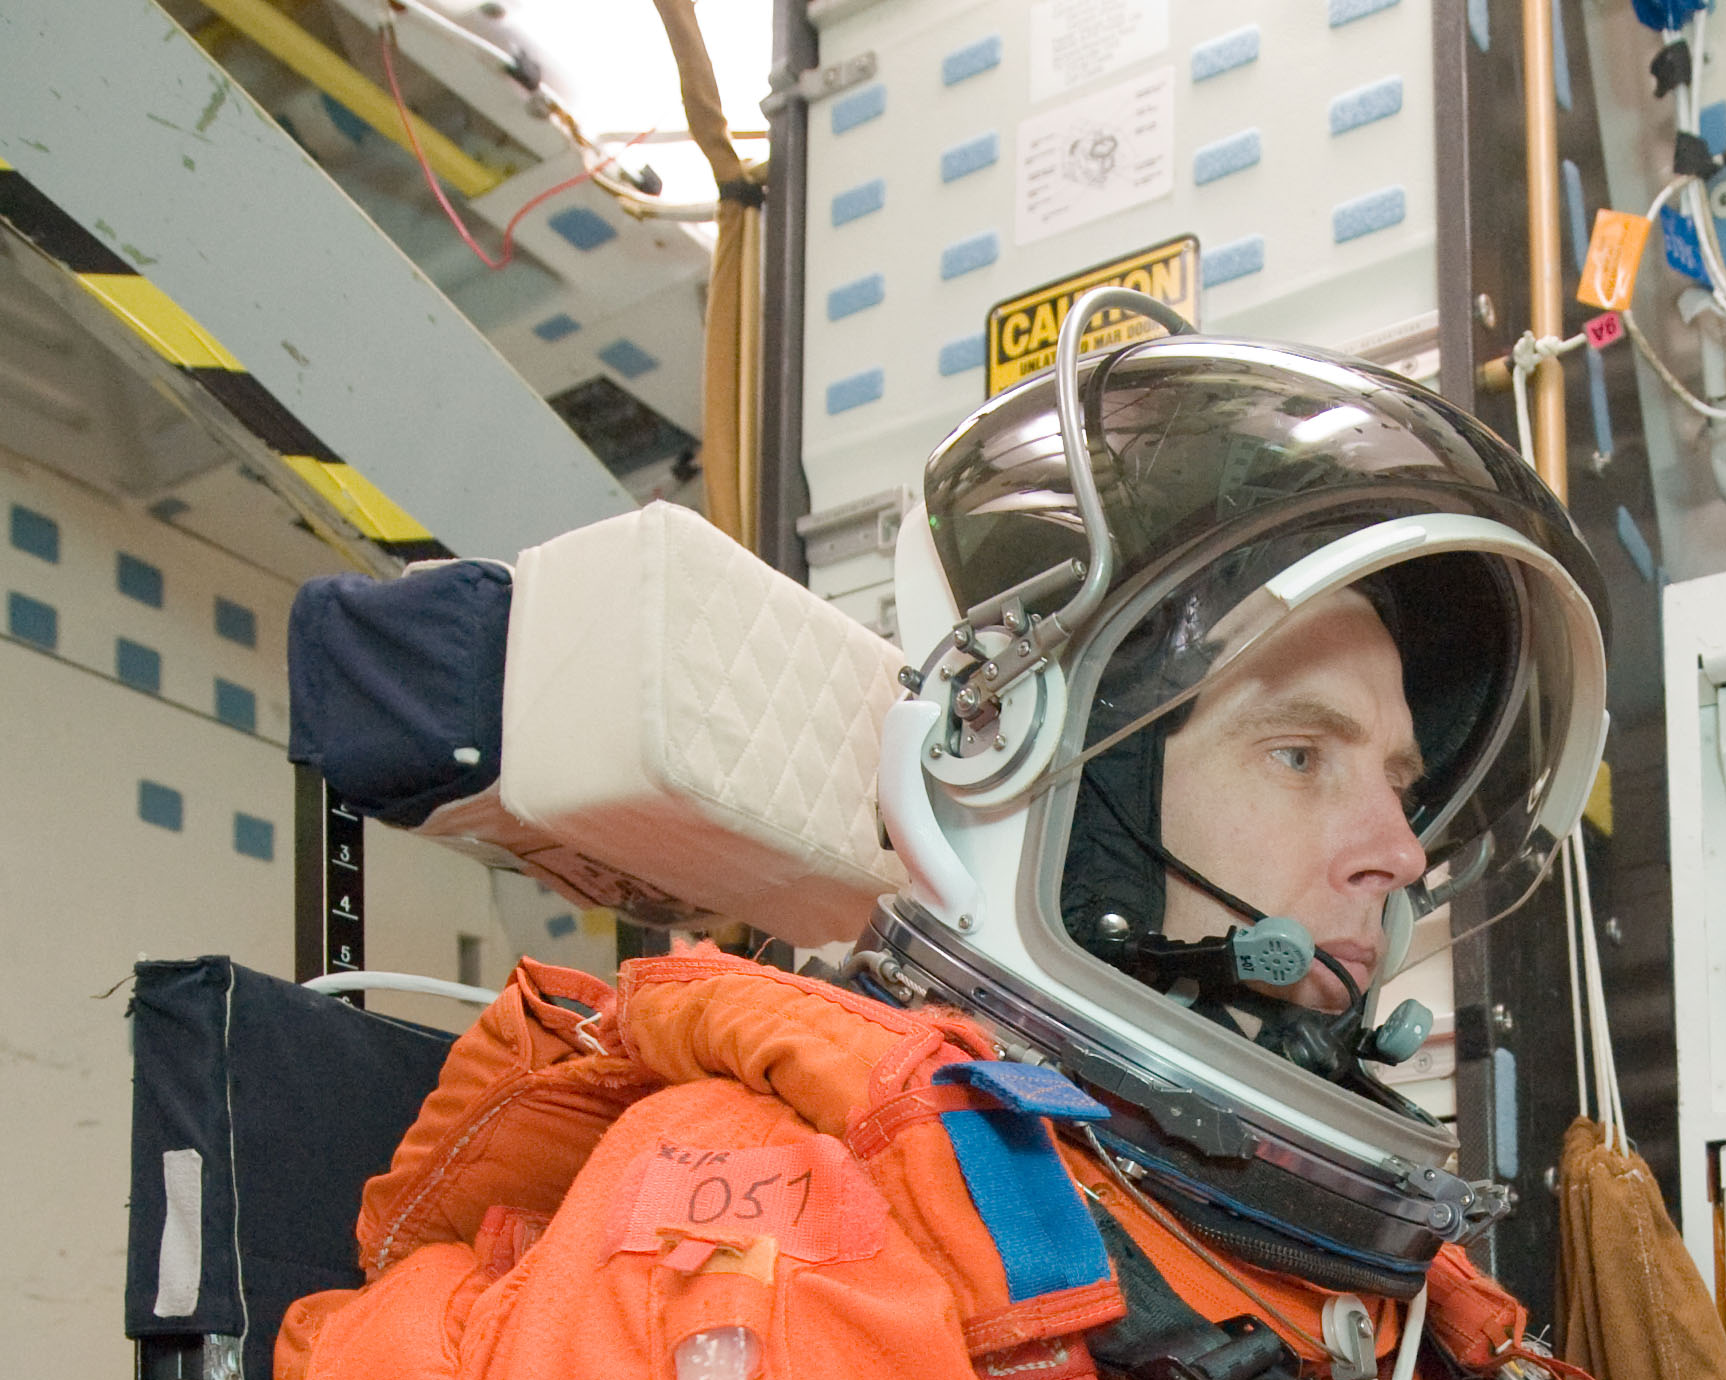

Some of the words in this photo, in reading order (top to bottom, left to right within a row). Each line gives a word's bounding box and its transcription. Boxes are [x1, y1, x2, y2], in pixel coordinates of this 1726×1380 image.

[339, 844, 350, 862] 3
[339, 895, 351, 912] 4
[340, 945, 351, 963] 5
